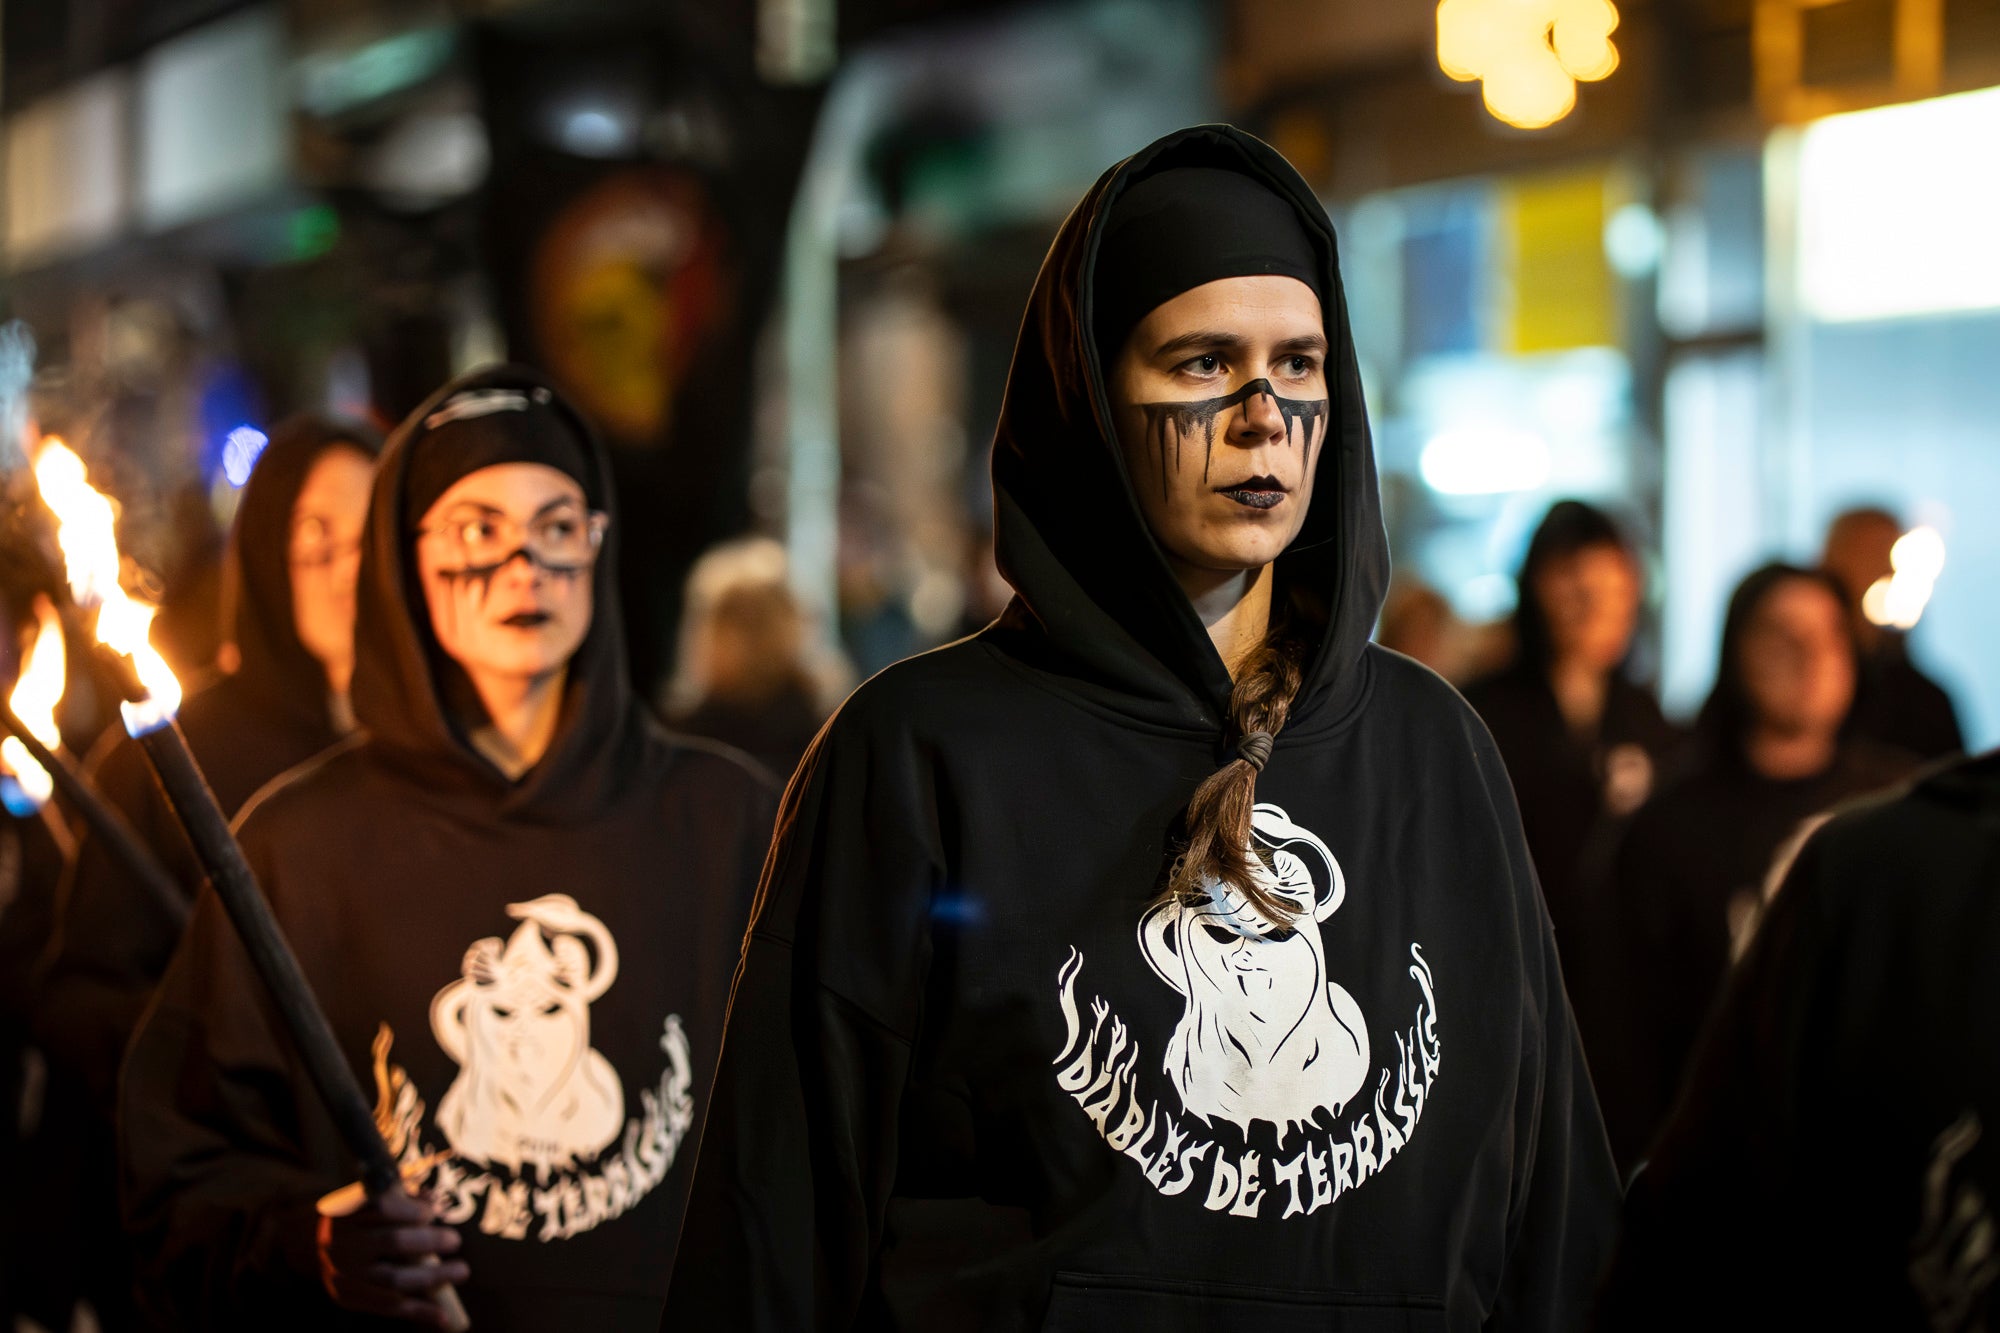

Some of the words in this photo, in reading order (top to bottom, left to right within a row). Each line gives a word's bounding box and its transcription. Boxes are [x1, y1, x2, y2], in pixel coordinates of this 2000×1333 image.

[1057, 1028, 1215, 1196] DIABLES
[1203, 1145, 1267, 1219] DE
[1272, 1003, 1441, 1220] TERRASSA
